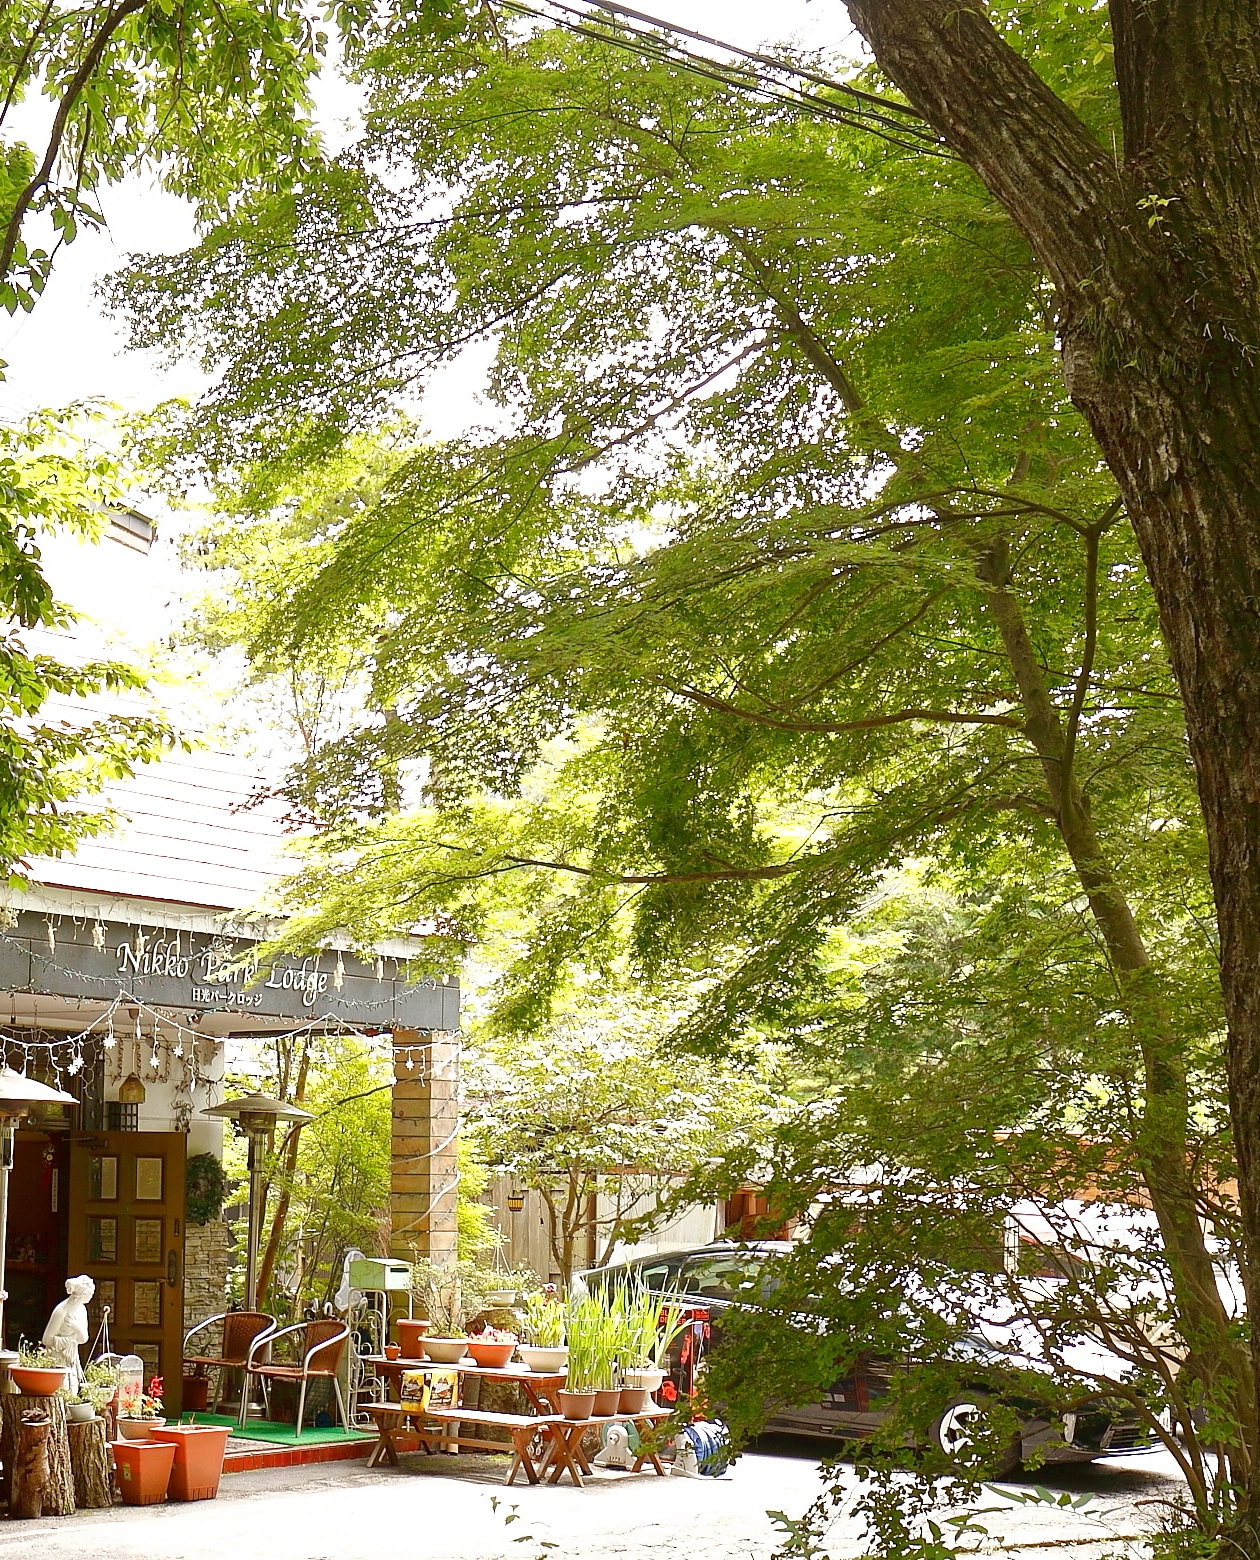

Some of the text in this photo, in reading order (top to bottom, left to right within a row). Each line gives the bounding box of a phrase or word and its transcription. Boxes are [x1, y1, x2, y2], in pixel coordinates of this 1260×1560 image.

[116, 939, 328, 1007] Nikko Park Lodge
[192, 987, 263, 1007] 日光パークロッジ
